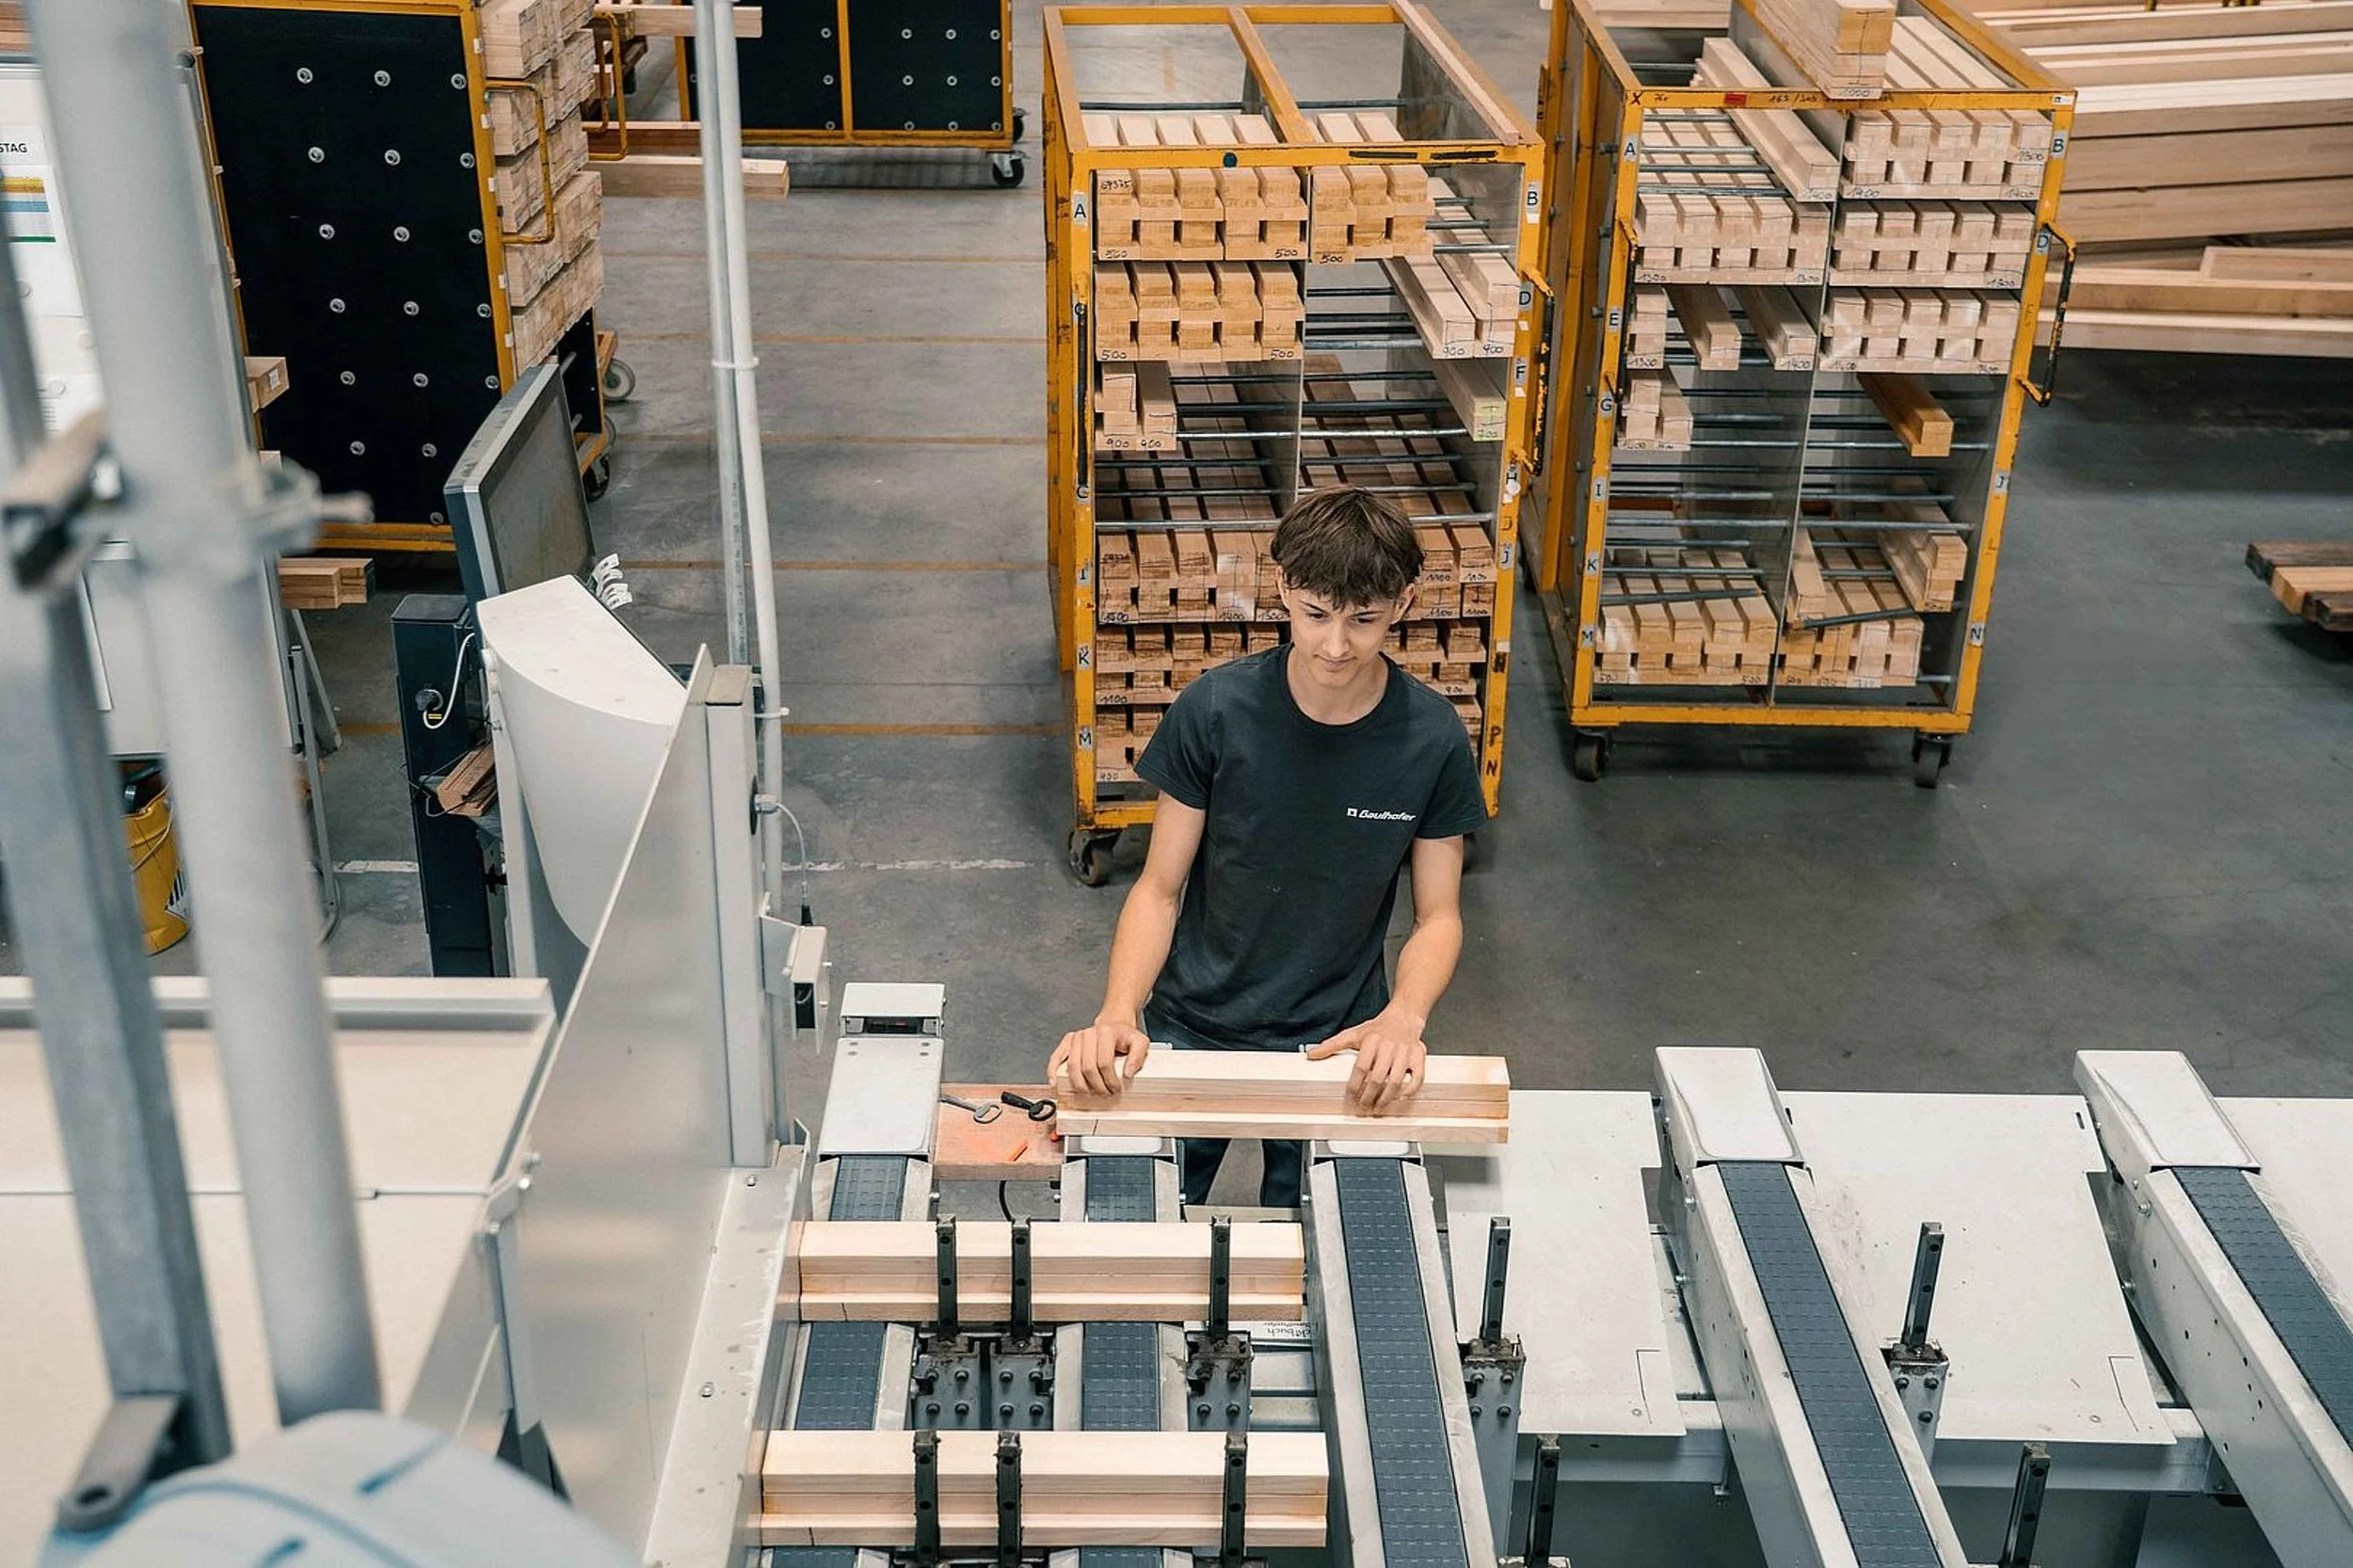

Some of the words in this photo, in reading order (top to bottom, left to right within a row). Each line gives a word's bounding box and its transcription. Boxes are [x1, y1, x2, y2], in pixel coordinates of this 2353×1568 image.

[1625, 142, 1636, 155] A
[2053, 138, 2065, 152] B
[1527, 191, 1538, 205] B
[1074, 203, 1086, 217] A
[2037, 234, 2049, 248] D
[1274, 248, 1299, 258] 500
[1519, 291, 1531, 305] D
[1609, 313, 1621, 326] E
[1101, 349, 1128, 360] 500
[1271, 349, 1295, 359] 500
[1516, 365, 1527, 379] F
[1600, 398, 1612, 411] G
[1587, 559, 1597, 571] K
[1581, 631, 1593, 641] M
[1970, 628, 1984, 640] N
[1079, 649, 1089, 664] K
[1079, 731, 1092, 744] M
[1486, 760, 1498, 776] N
[1358, 809, 1417, 821] Gaulhofer
